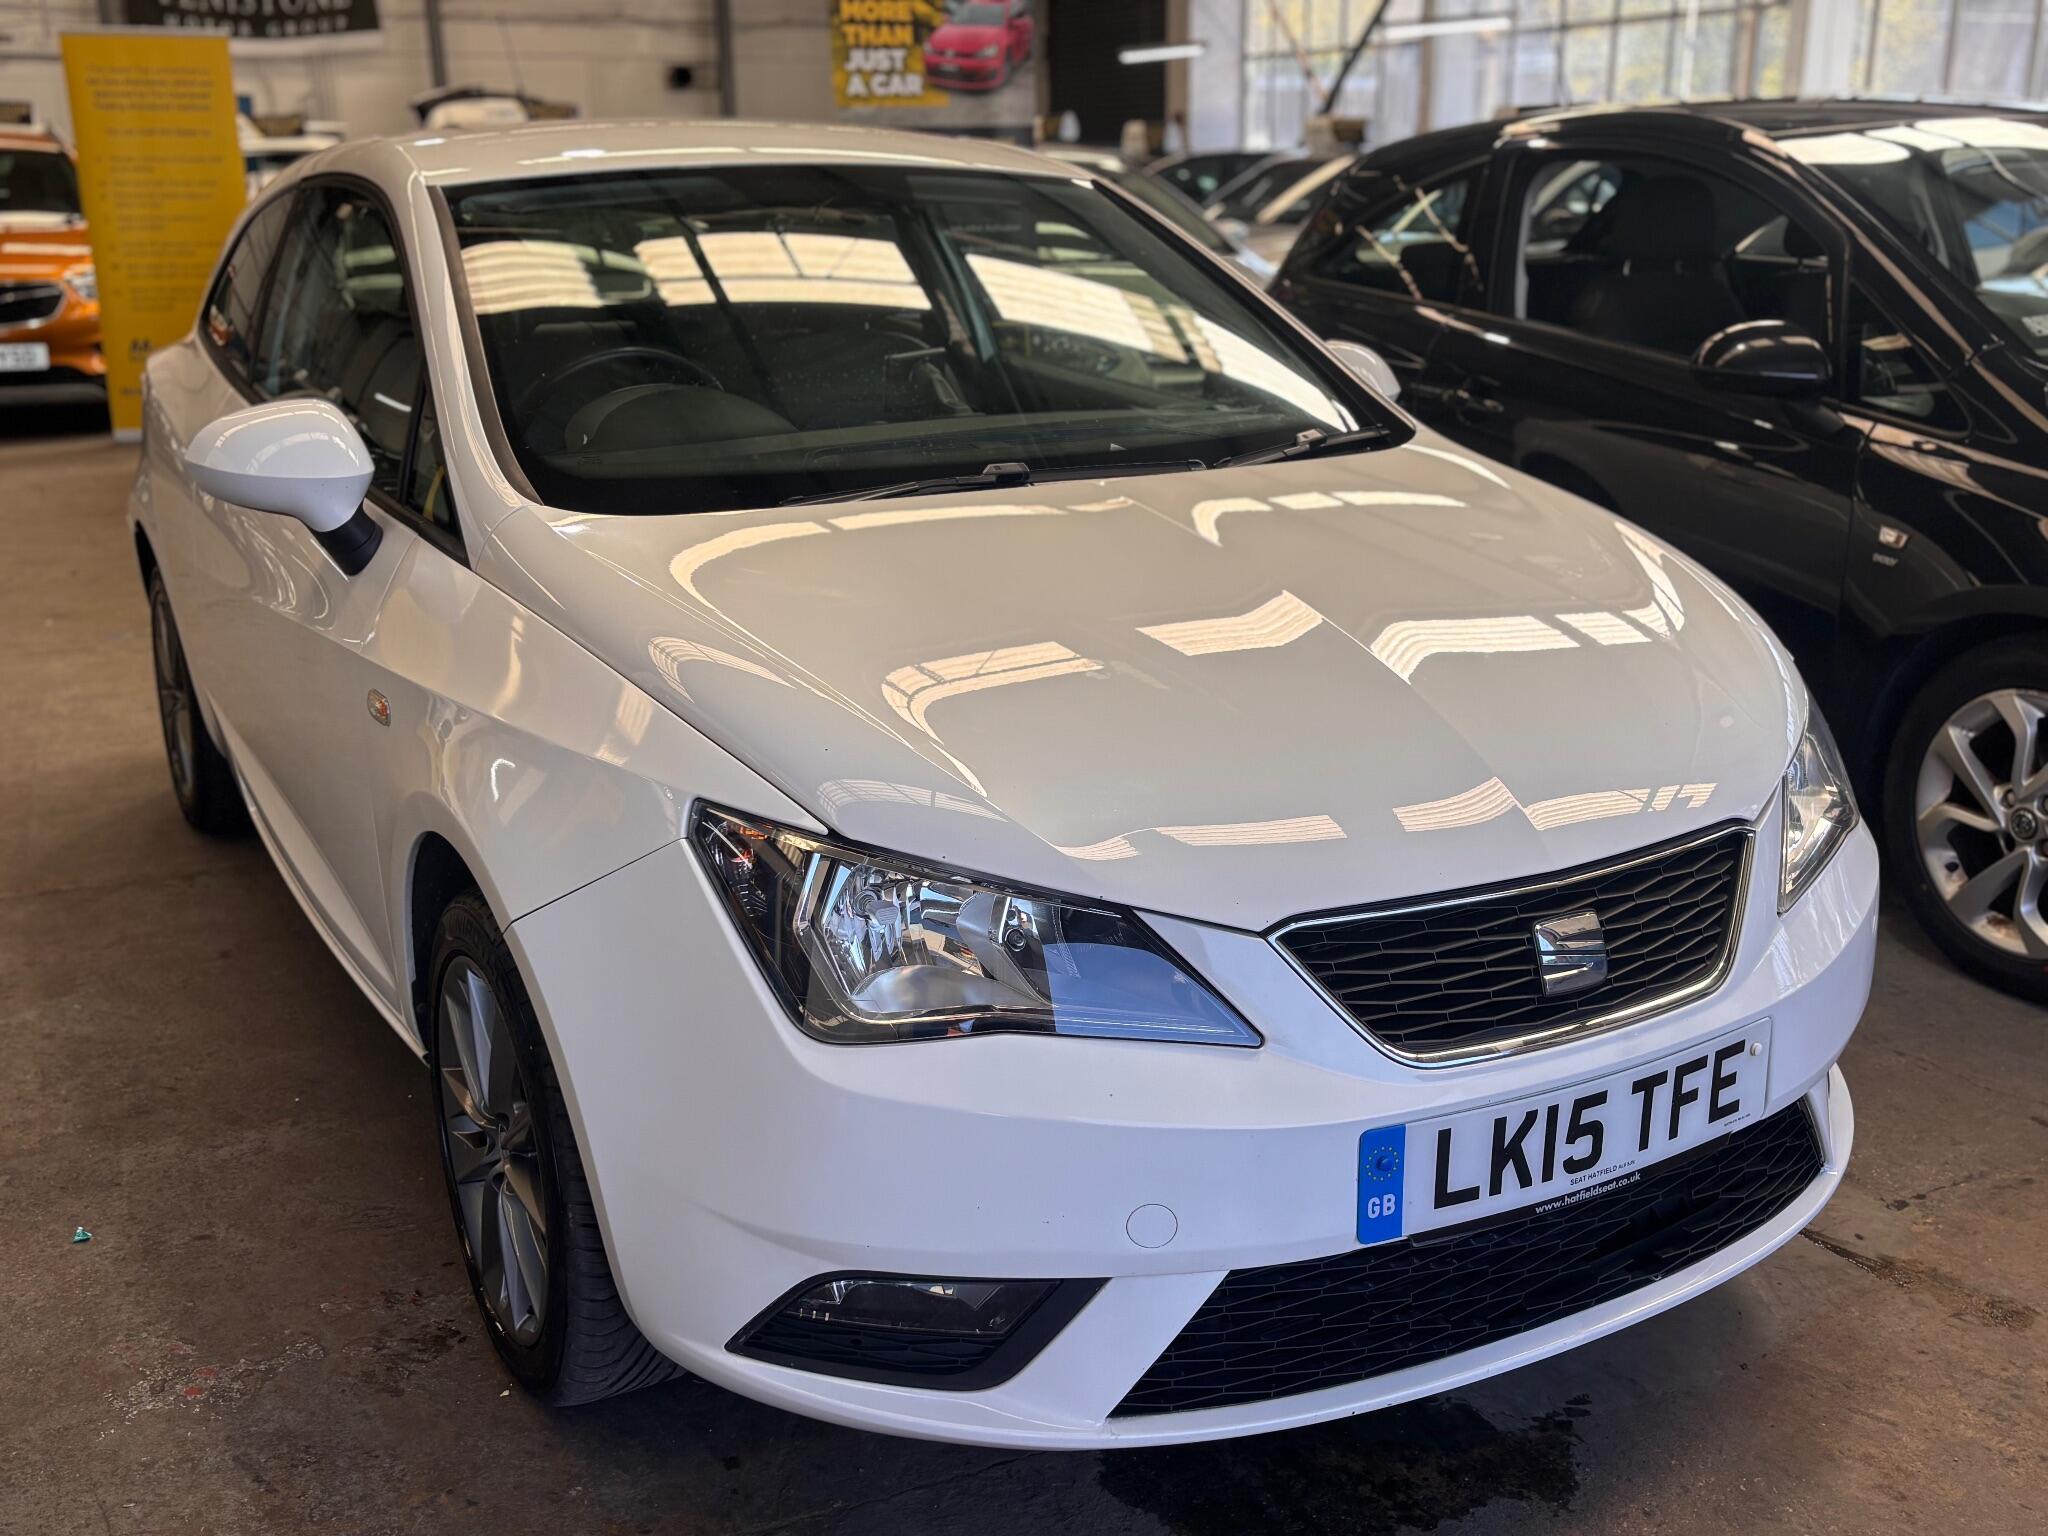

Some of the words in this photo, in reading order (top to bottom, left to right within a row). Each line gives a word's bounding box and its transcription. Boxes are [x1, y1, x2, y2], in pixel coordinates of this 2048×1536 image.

[841, 0, 912, 20] MORE
[266, 14, 349, 37] GROUP
[842, 23, 913, 45] THAN
[844, 48, 907, 72] JUST
[846, 73, 868, 97] A
[870, 72, 923, 97] CAR
[1433, 1090, 1608, 1210] LK15
[1631, 1038, 1746, 1153] TFE
[1570, 1175, 1587, 1186] SEAT
[1587, 1165, 1618, 1180] HATFIELD
[1535, 1171, 1641, 1214] www.hatfieldseat.co.uk
[1367, 1193, 1396, 1219] GB
